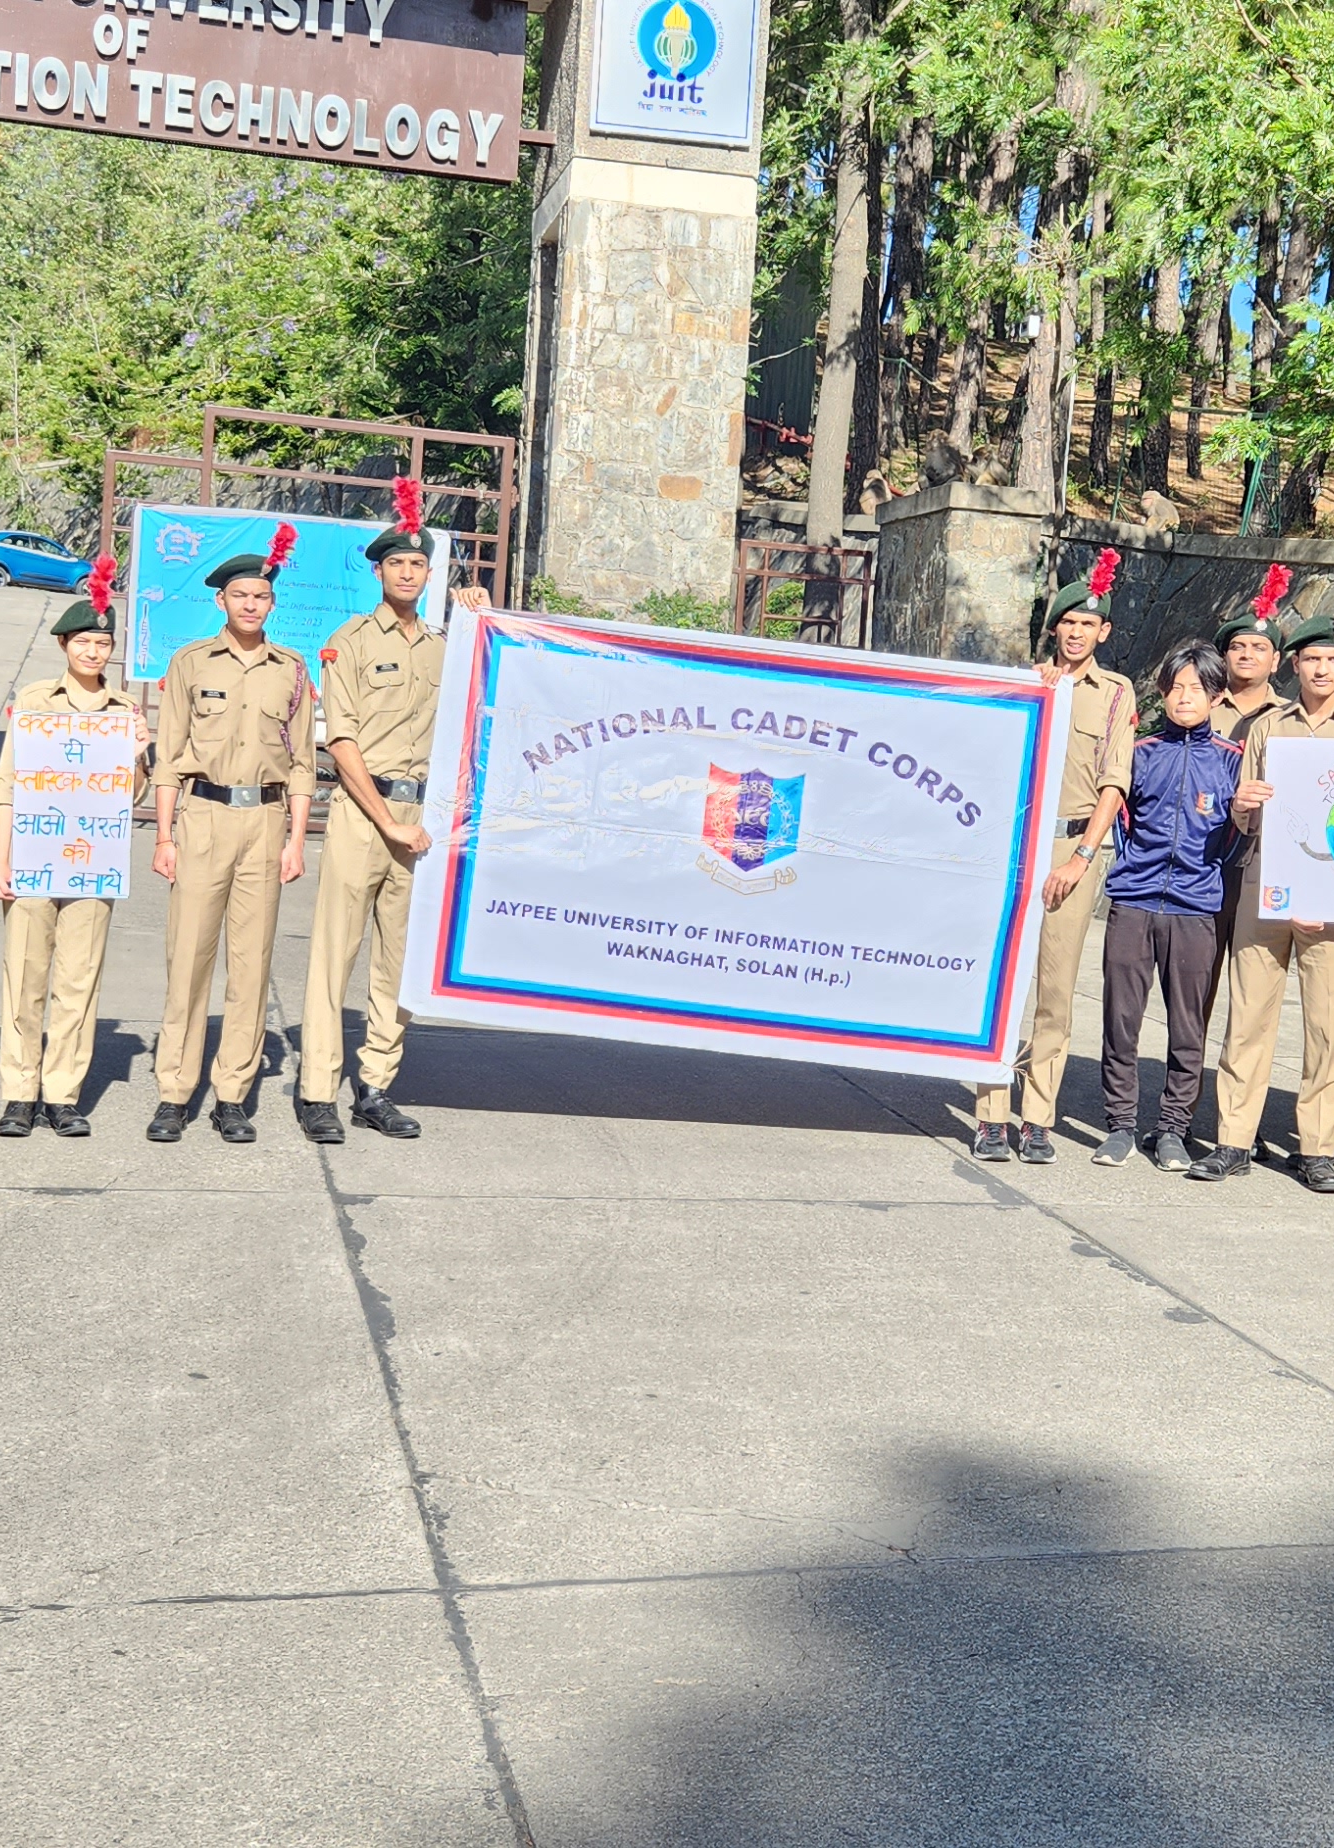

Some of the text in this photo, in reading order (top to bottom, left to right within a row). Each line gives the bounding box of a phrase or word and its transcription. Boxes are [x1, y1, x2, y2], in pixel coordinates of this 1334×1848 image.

[93, 13, 150, 60] OF
[642, 69, 705, 104] juit
[130, 69, 504, 163] TECHNOLOGY
[301, 617, 323, 627] 2023
[522, 706, 982, 828] NATIONAL CADET CORPS
[13, 806, 130, 839] आओ धरती
[62, 837, 95, 865] को
[485, 899, 976, 972] JAYPEE UNIVERSITY OF INFORMATION TECHNOLOGY
[607, 941, 852, 988] WAKNAGHAT, SOLAN (H.p.)
